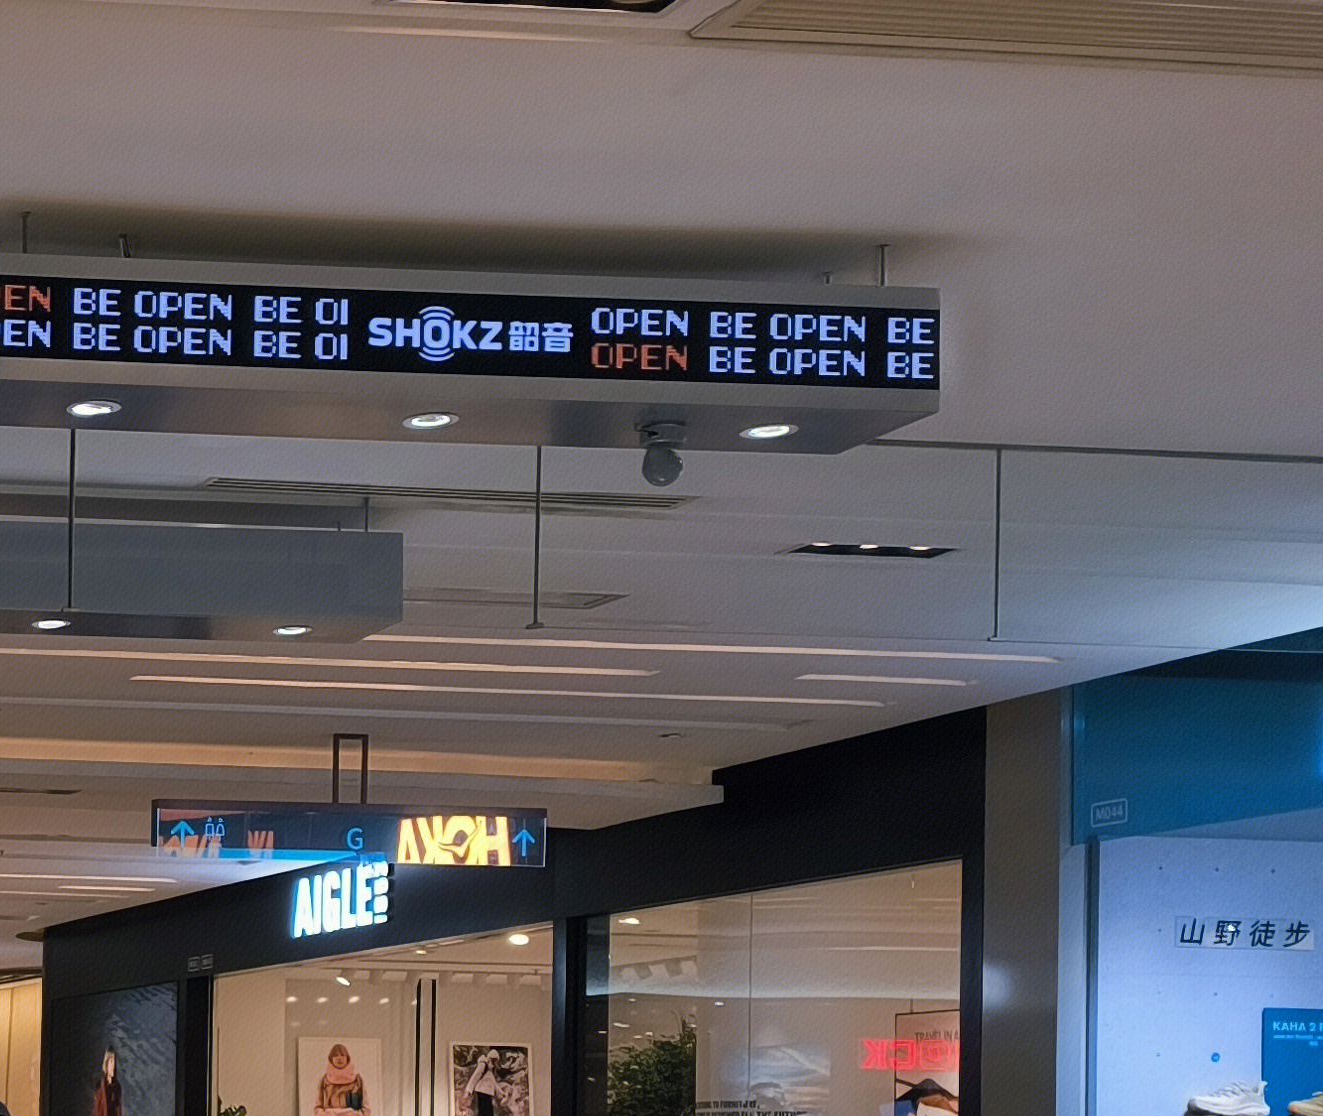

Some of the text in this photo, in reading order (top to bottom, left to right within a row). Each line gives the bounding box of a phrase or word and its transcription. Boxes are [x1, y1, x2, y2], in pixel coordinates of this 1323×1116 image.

[73, 287, 122, 317] BE
[134, 291, 233, 322] OPEN
[254, 296, 304, 325] BE
[73, 323, 122, 352] BE
[134, 325, 233, 356] OPEN
[254, 330, 303, 358] BE
[368, 316, 503, 350] SHOKZ
[508, 321, 574, 353] 韶音
[591, 307, 935, 344] OPEN BE OPEN BE
[591, 342, 935, 379] OPEN BE OPEN BE
[346, 827, 364, 850] G
[292, 862, 375, 938] AIGLE
[1178, 917, 1311, 948] 山野徒步
